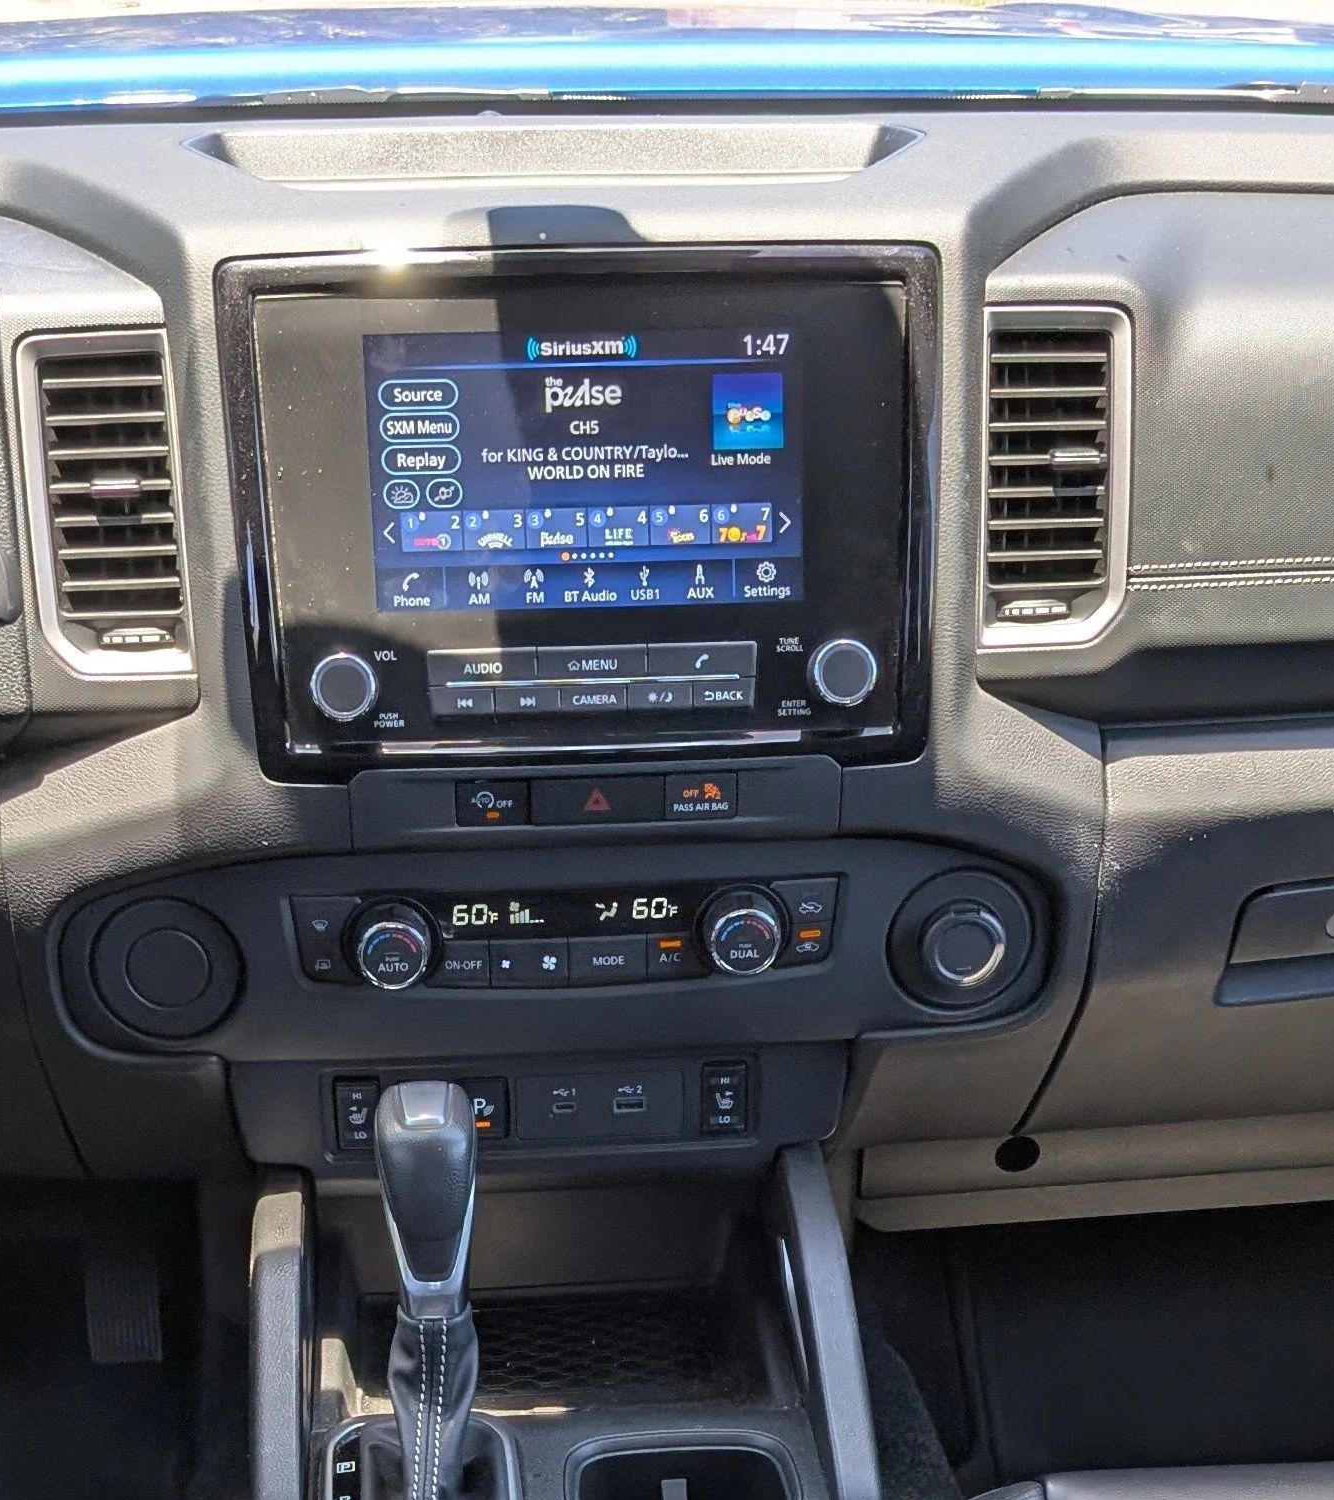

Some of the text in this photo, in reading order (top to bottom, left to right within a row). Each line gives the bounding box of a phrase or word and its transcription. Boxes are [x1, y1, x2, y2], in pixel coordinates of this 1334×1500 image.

[743, 333, 790, 356] 1:47
[544, 376, 563, 386] the
[393, 388, 443, 402] Source
[545, 378, 623, 413] pulse
[386, 420, 453, 435] SXM Menu
[569, 420, 600, 435] CH5
[397, 452, 446, 470] Replay
[481, 448, 503, 463] for
[507, 448, 543, 462] KING
[547, 447, 559, 461] &
[711, 453, 772, 466] Live Mode
[528, 464, 645, 480] WORLD ON FIRE
[531, 514, 539, 526] 3
[575, 512, 585, 526] 5
[593, 513, 602, 524] 4
[637, 510, 647, 525] 4
[656, 511, 664, 522] 5
[699, 509, 709, 523] 6
[717, 510, 725, 521] 6
[760, 507, 770, 521] 7
[408, 518, 414, 528] 1
[451, 516, 461, 529] 2
[469, 517, 477, 528] 2
[513, 514, 523, 528] 3
[604, 528, 633, 540] LIFE
[526, 592, 544, 603] FM
[564, 590, 617, 602] BT Audio
[630, 588, 660, 600] USB1
[687, 586, 715, 599] AUX
[743, 585, 791, 599] Settings
[393, 595, 431, 607] Phone
[468, 593, 490, 605] AM
[776, 644, 804, 652] SCROLL
[373, 650, 397, 662] VOL
[463, 662, 503, 675] AUDIO
[581, 659, 618, 671] MENU
[572, 693, 617, 706] CAMERA
[715, 690, 744, 701] BACK
[373, 719, 405, 728] POWER
[682, 788, 700, 798] OFF
[496, 799, 513, 808] OFF
[673, 801, 729, 812] PASS AIR BAG
[659, 953, 681, 963] A/C
[730, 948, 760, 959] DUAL
[445, 960, 483, 970] ON-OFF
[592, 955, 625, 966] MODE
[377, 962, 409, 973] AUTO
[720, 1077, 730, 1085] HI
[571, 1087, 576, 1096] 1
[636, 1085, 643, 1094] 2
[718, 1115, 731, 1124] LO
[353, 1131, 367, 1140] LO
